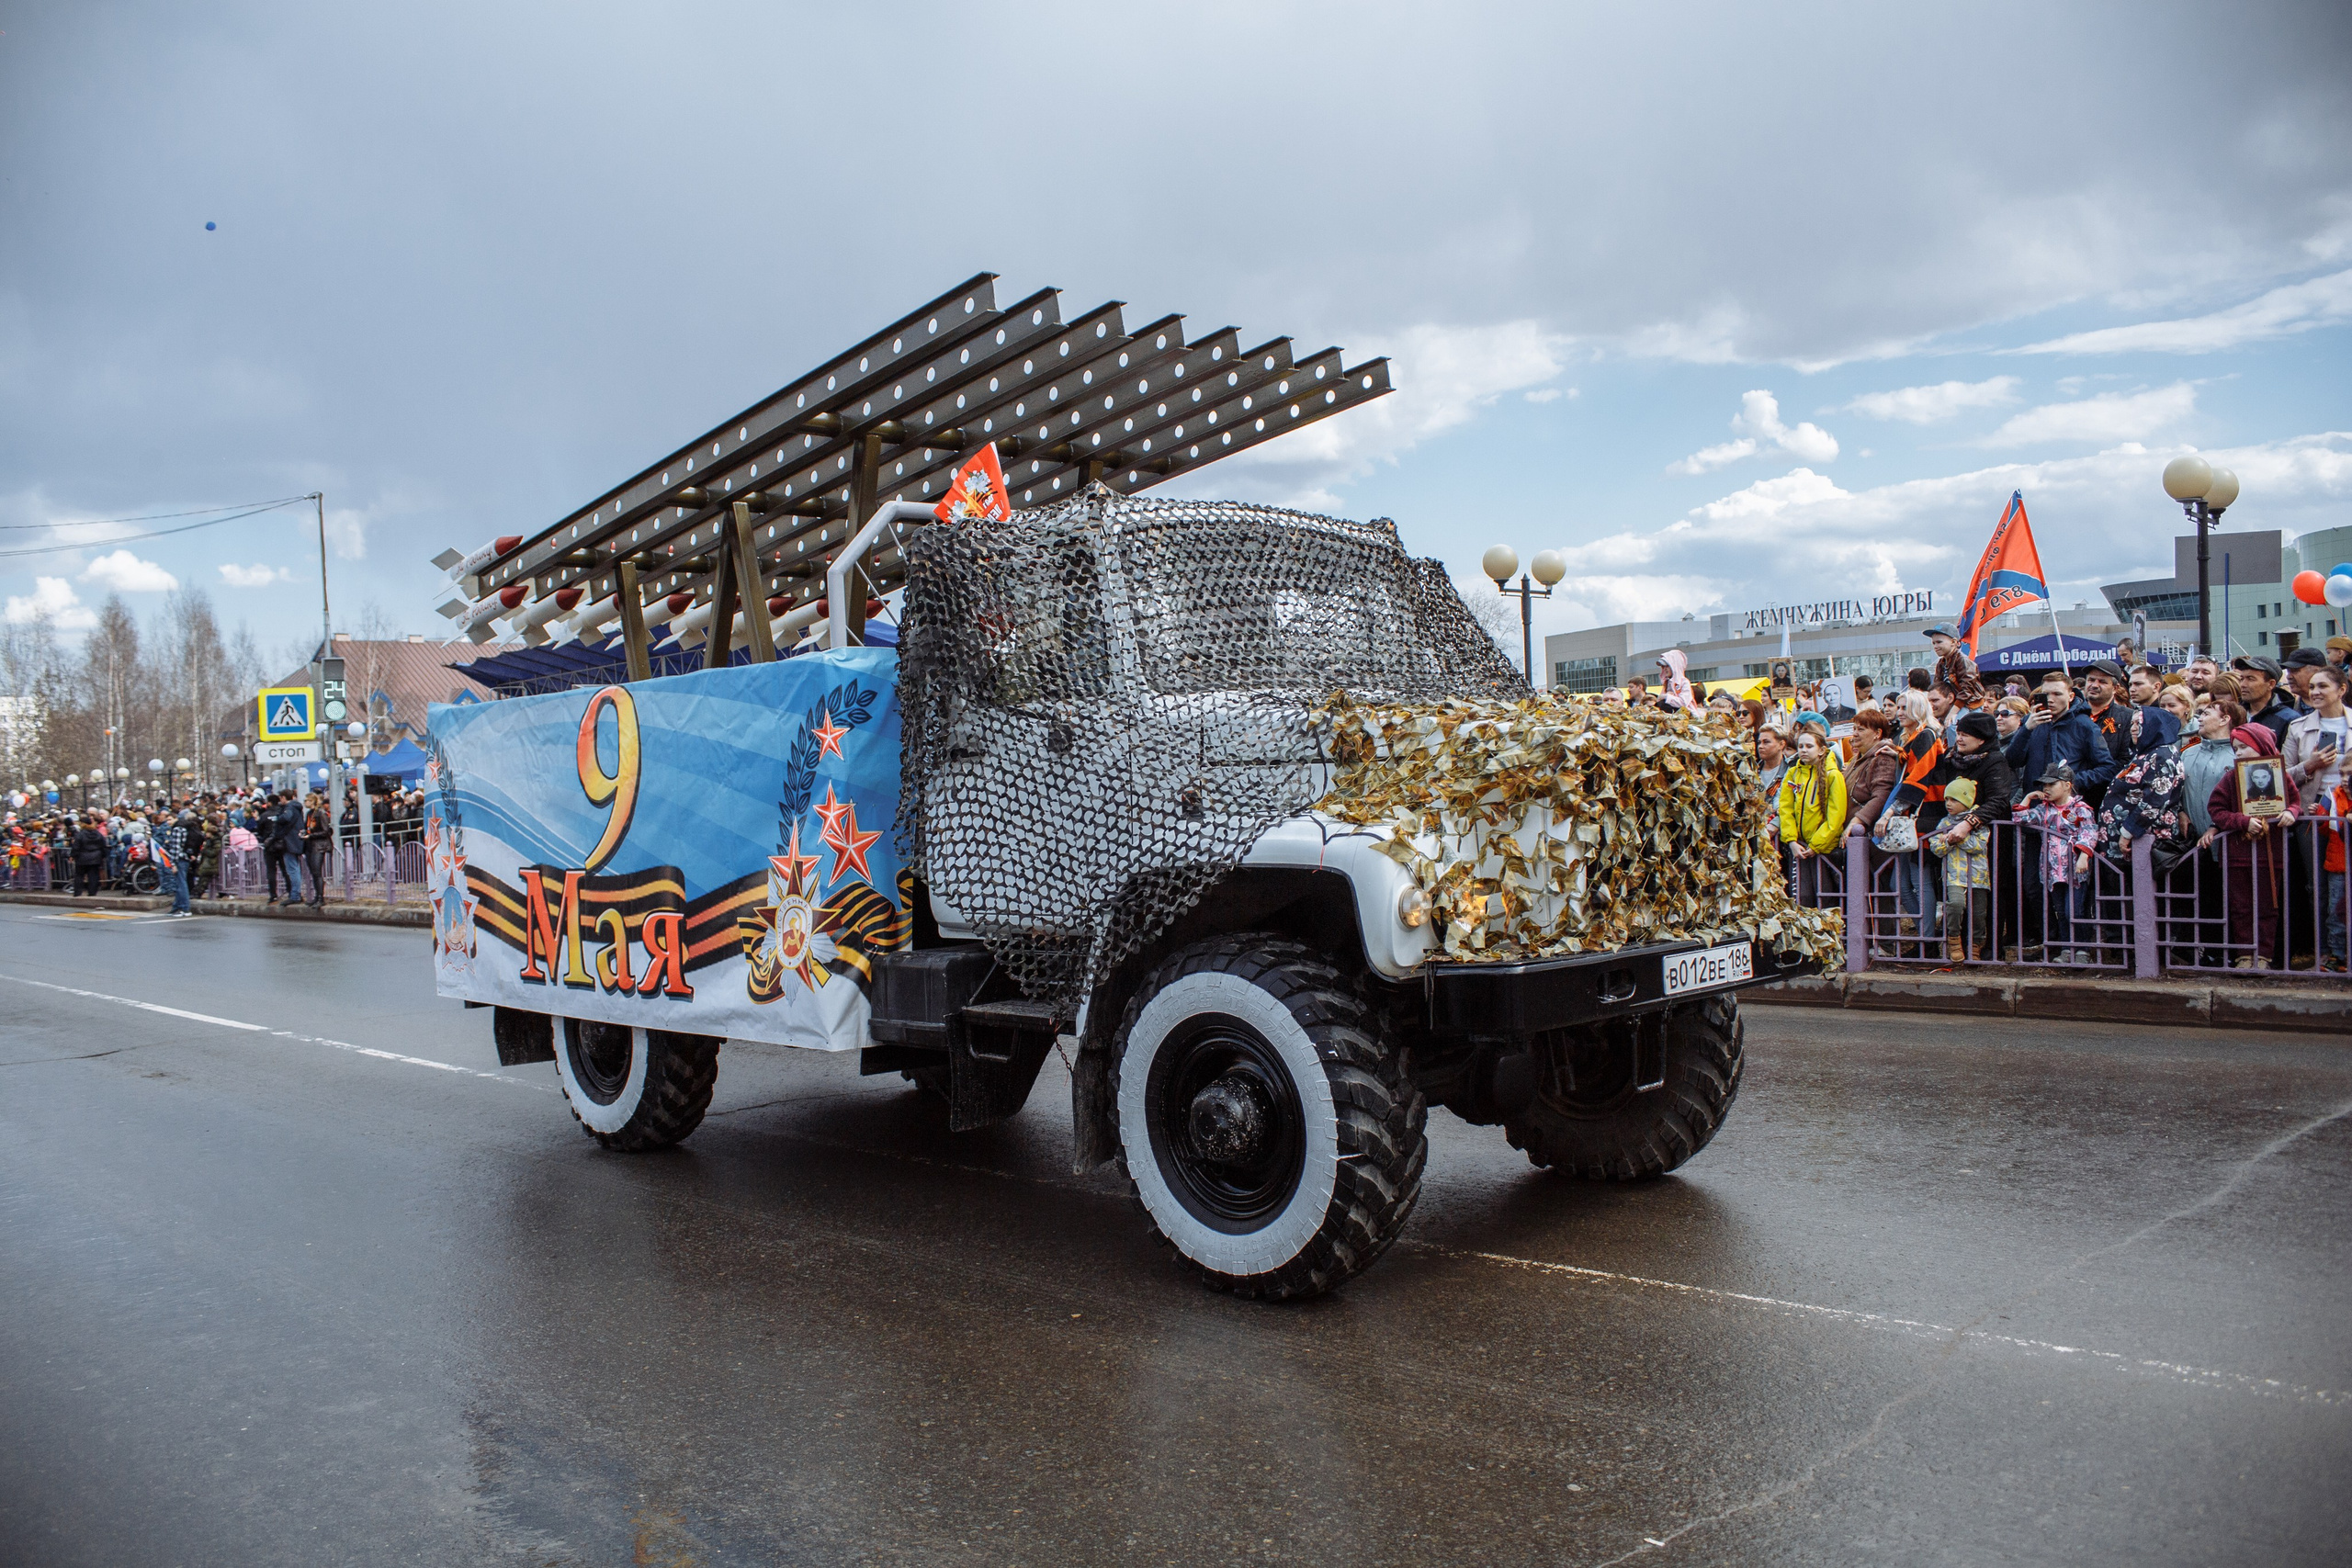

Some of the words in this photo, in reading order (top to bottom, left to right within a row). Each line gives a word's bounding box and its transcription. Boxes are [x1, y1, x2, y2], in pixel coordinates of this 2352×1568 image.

[1746, 599, 1864, 628] ЖЕМЧУЖИНА
[1872, 591, 1934, 616] ЮГРЫ
[1999, 651, 2009, 664] С
[2012, 649, 2051, 665] Днём
[2053, 647, 2117, 662] Победы!
[324, 681, 346, 699] 24
[268, 748, 305, 758] СТОП
[577, 685, 641, 871] 9
[519, 867, 695, 1003] Мая
[1668, 955, 1725, 989] В012ВЕ
[1728, 947, 1748, 969] 186
[1733, 968, 1743, 978] RUS
